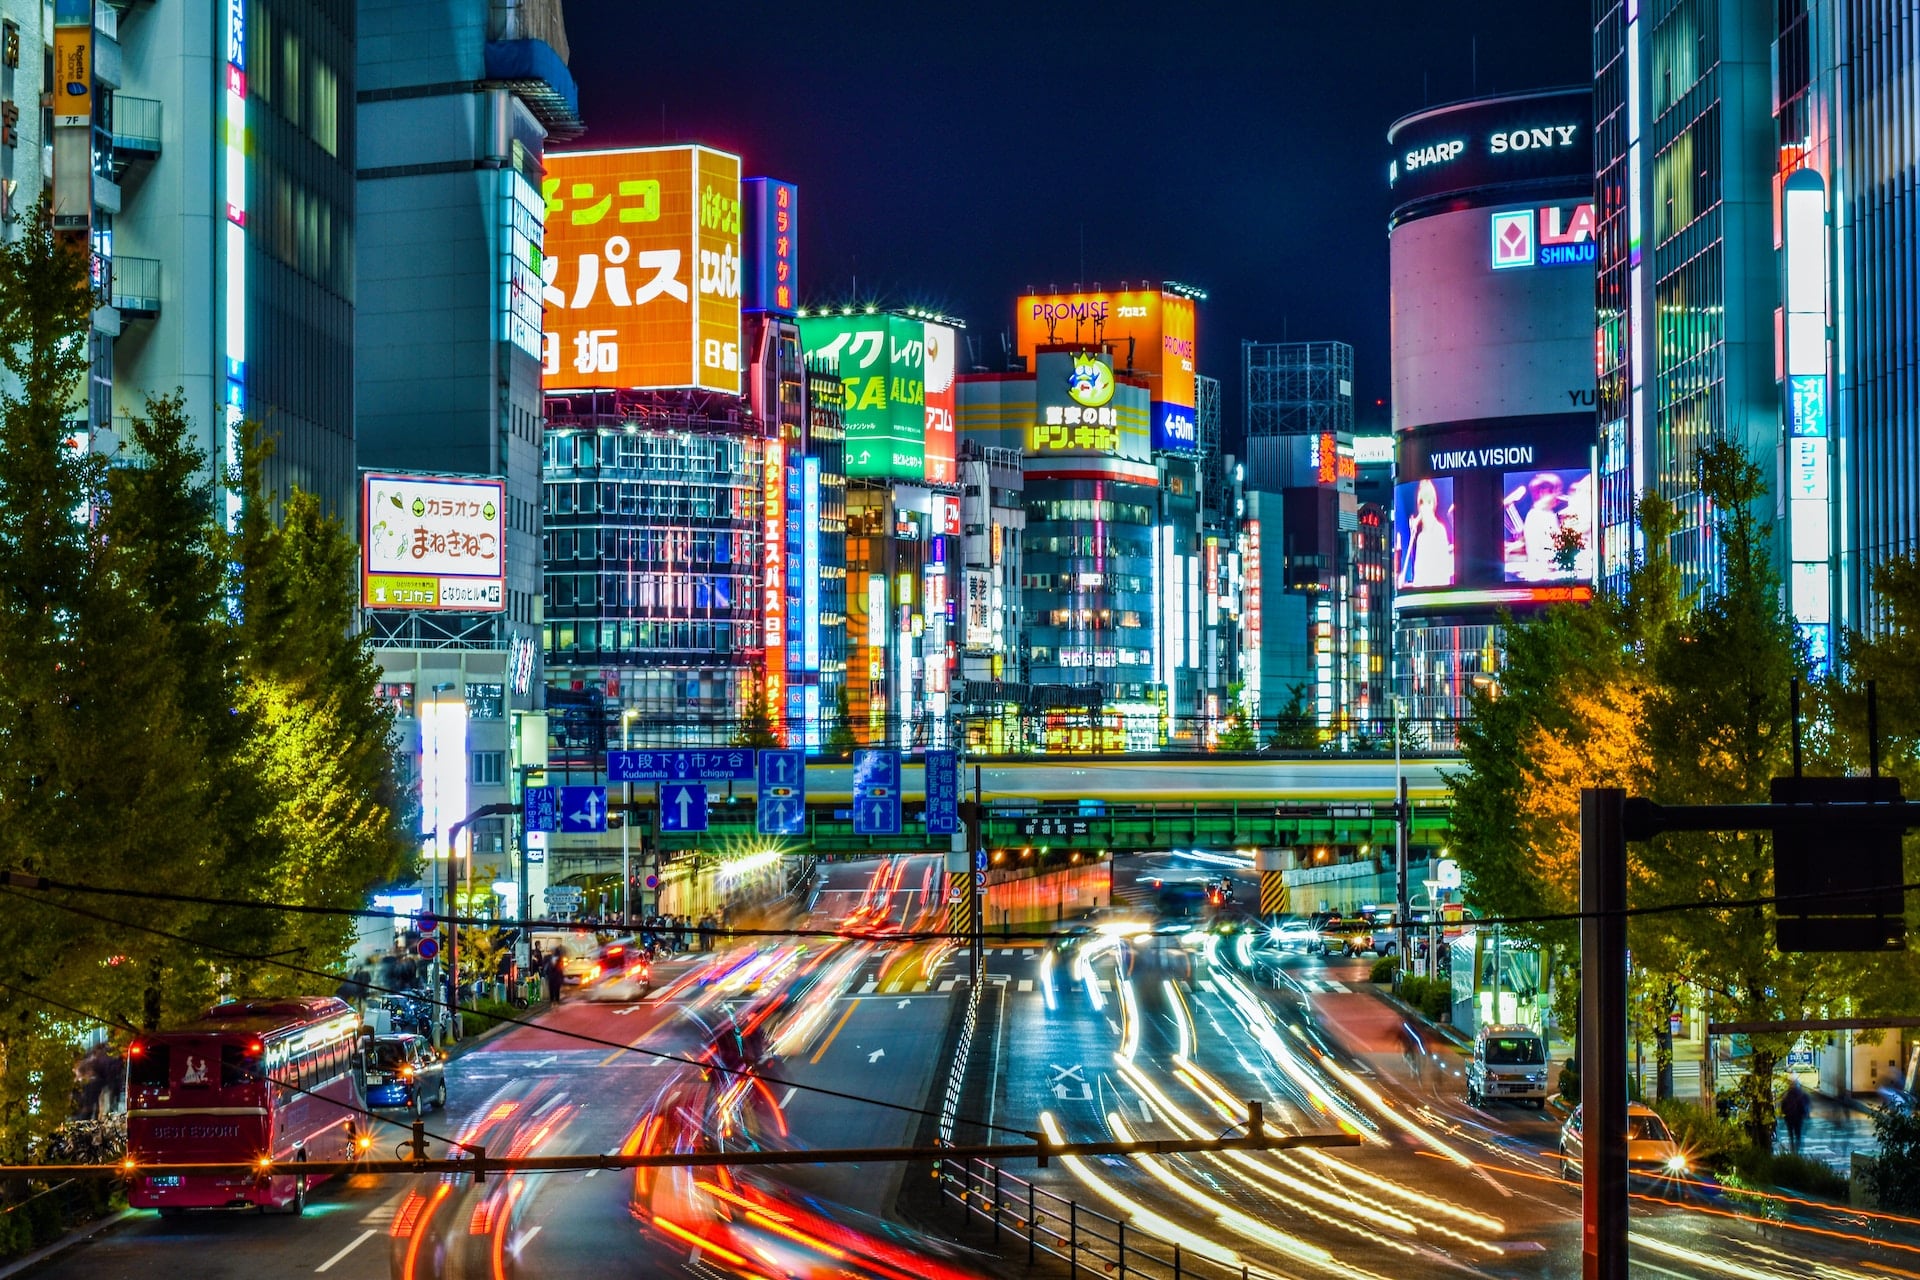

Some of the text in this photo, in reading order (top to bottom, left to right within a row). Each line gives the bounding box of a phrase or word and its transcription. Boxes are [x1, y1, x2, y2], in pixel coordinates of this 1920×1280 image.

[67, 52, 76, 80] Stone
[76, 45, 85, 80] Rosetta
[66, 116, 79, 125] 7F
[1490, 125, 1577, 153] SONY
[1406, 140, 1464, 171] SHARP
[65, 217, 79, 226] 6F
[701, 184, 741, 235] パチンコ
[777, 187, 790, 308] カラオケ館
[1540, 244, 1594, 265] SHINJU
[701, 243, 741, 299] エスパス
[1033, 302, 1109, 321] PROMISE
[1117, 306, 1147, 318] プロミス
[705, 339, 737, 371] 日拓
[891, 335, 922, 369] レイク
[1164, 335, 1193, 359] PROMISE
[890, 377, 924, 406] ALSA
[926, 406, 953, 432] アコム
[1803, 378, 1819, 434] オアシス
[1174, 415, 1194, 441] 50m
[1431, 446, 1533, 471] YUNIKA VISION
[765, 443, 781, 516] パチンコ
[427, 499, 480, 518] カラオケ
[411, 525, 496, 560] まねきねこ
[765, 520, 780, 612] エスパス
[393, 589, 434, 602] ワンカラ
[441, 586, 480, 601] となりのビル
[618, 753, 673, 770] 九段下
[622, 769, 735, 780] Kudanshita Ichigaya
[928, 756, 939, 794] Shinjuku
[939, 754, 953, 829] 新宿駅東口
[537, 788, 553, 830] 小滝橋
[1025, 824, 1067, 835] 新宿駅
[155, 1125, 240, 1139] BEST ESCORT
